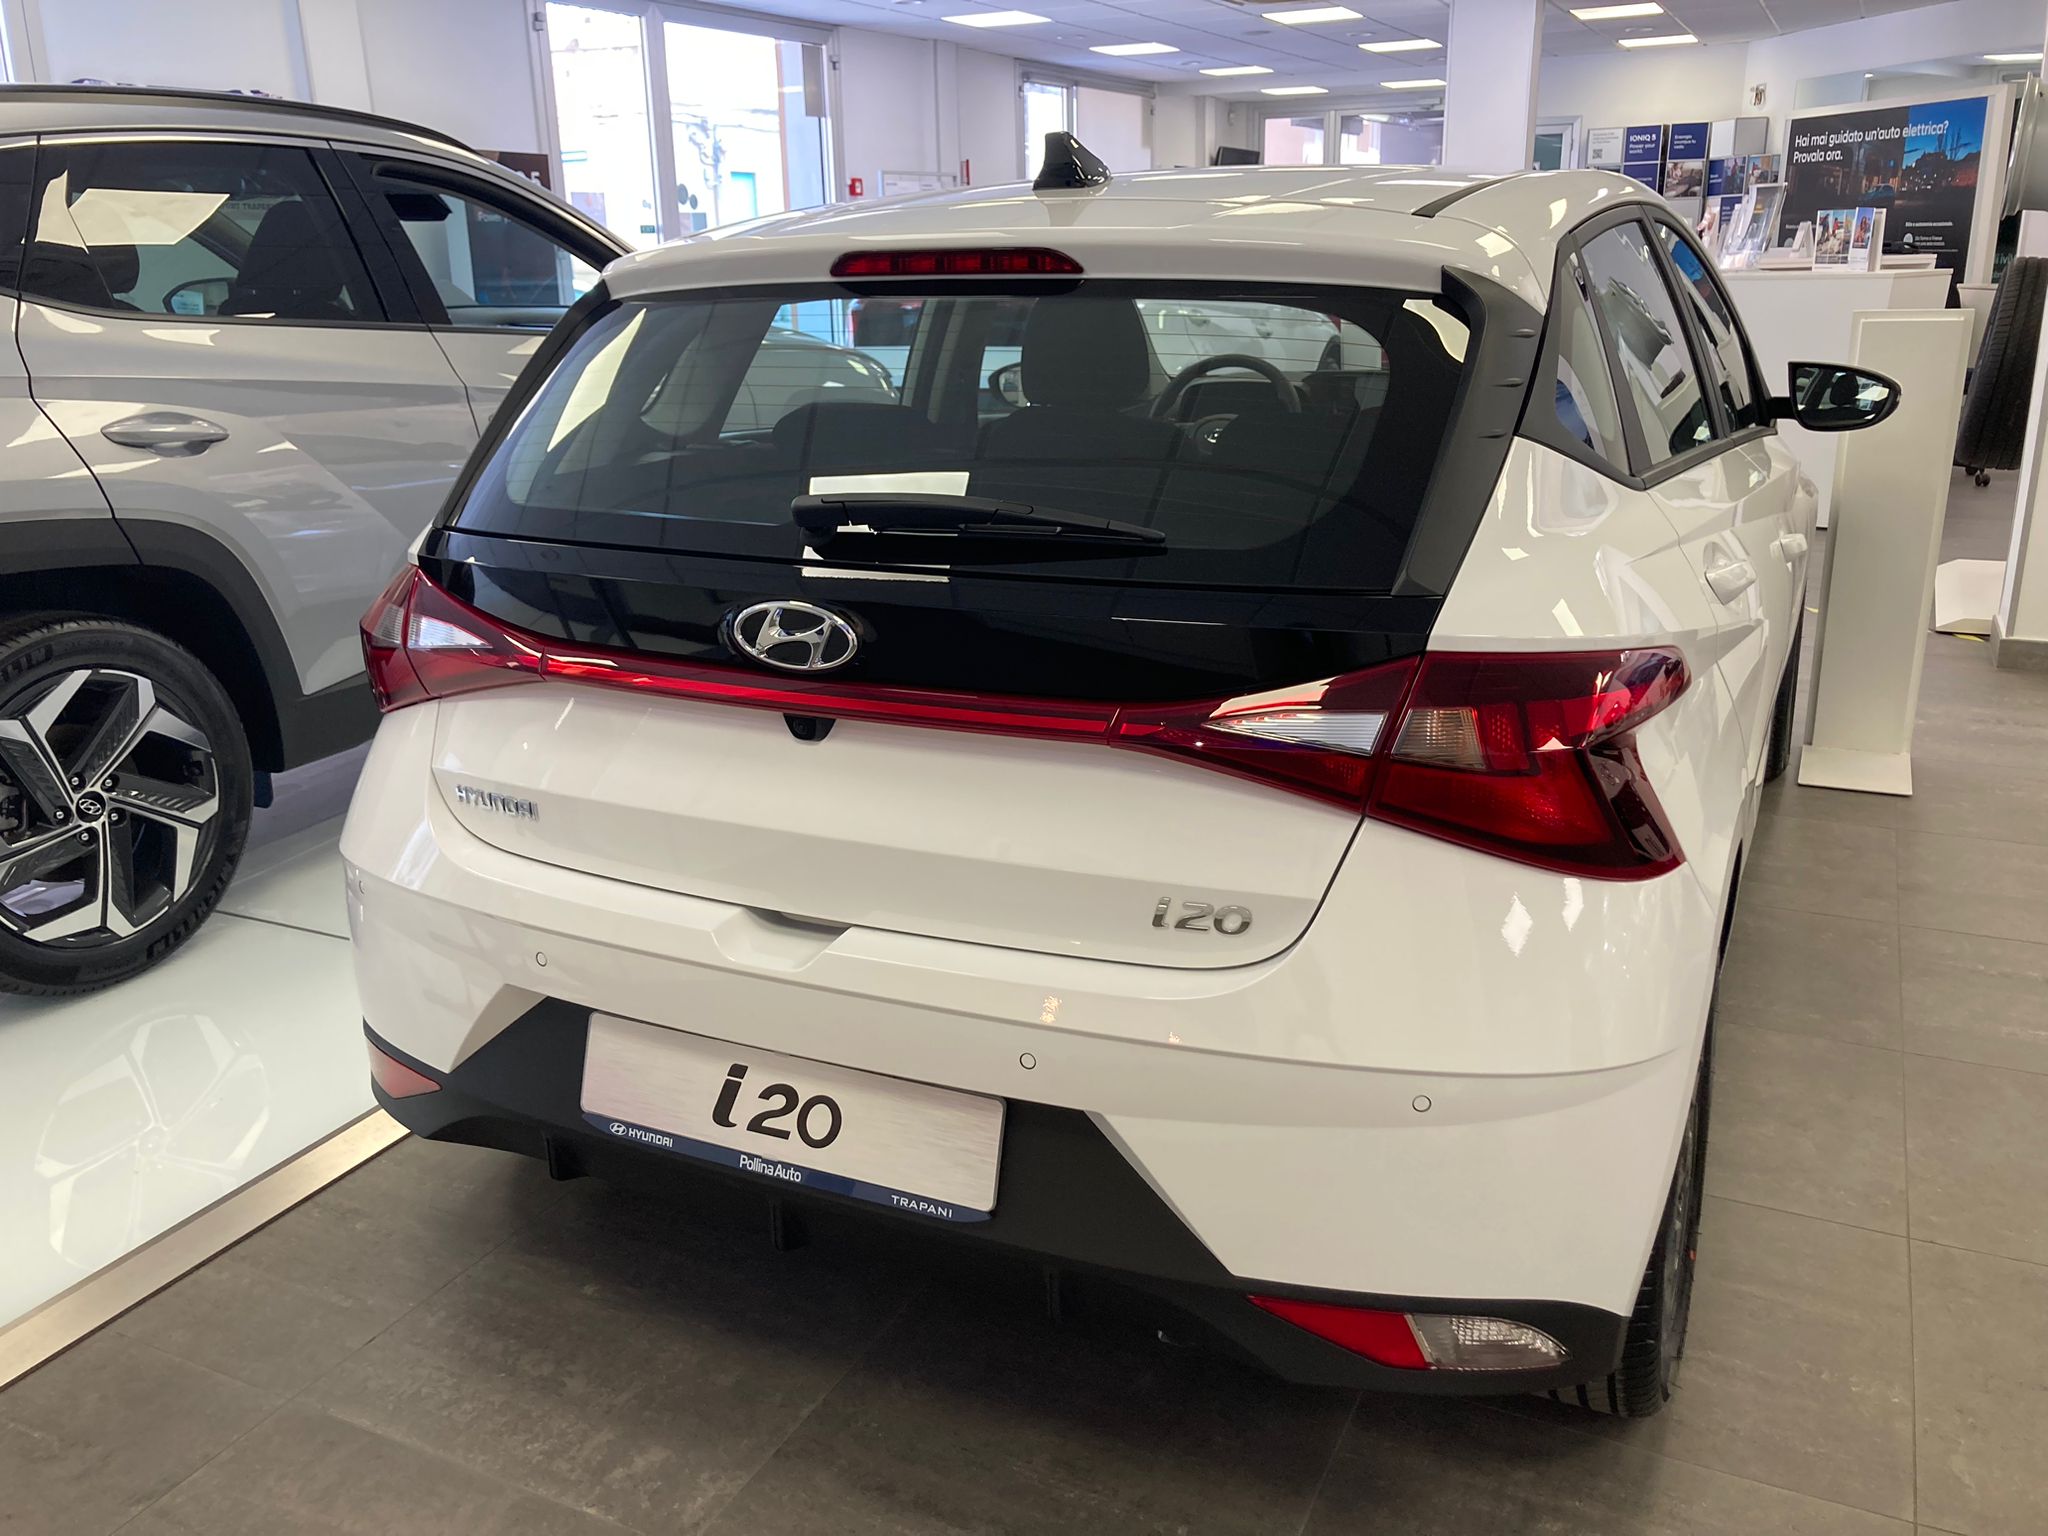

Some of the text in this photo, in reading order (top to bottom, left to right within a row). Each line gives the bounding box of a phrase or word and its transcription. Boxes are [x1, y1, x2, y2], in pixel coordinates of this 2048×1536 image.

[1629, 133, 1651, 142] IONIQ
[1652, 133, 1656, 141] 5
[1795, 120, 1949, 147] Hai mai guidato un'auto elettrica?
[1793, 149, 1843, 164] Provala ora.
[456, 784, 540, 821] HYUNDAI
[1151, 896, 1253, 936] i20
[712, 1063, 842, 1149] i20
[628, 1128, 673, 1147] HYUNDAI
[891, 1194, 953, 1218] TRAPANI
